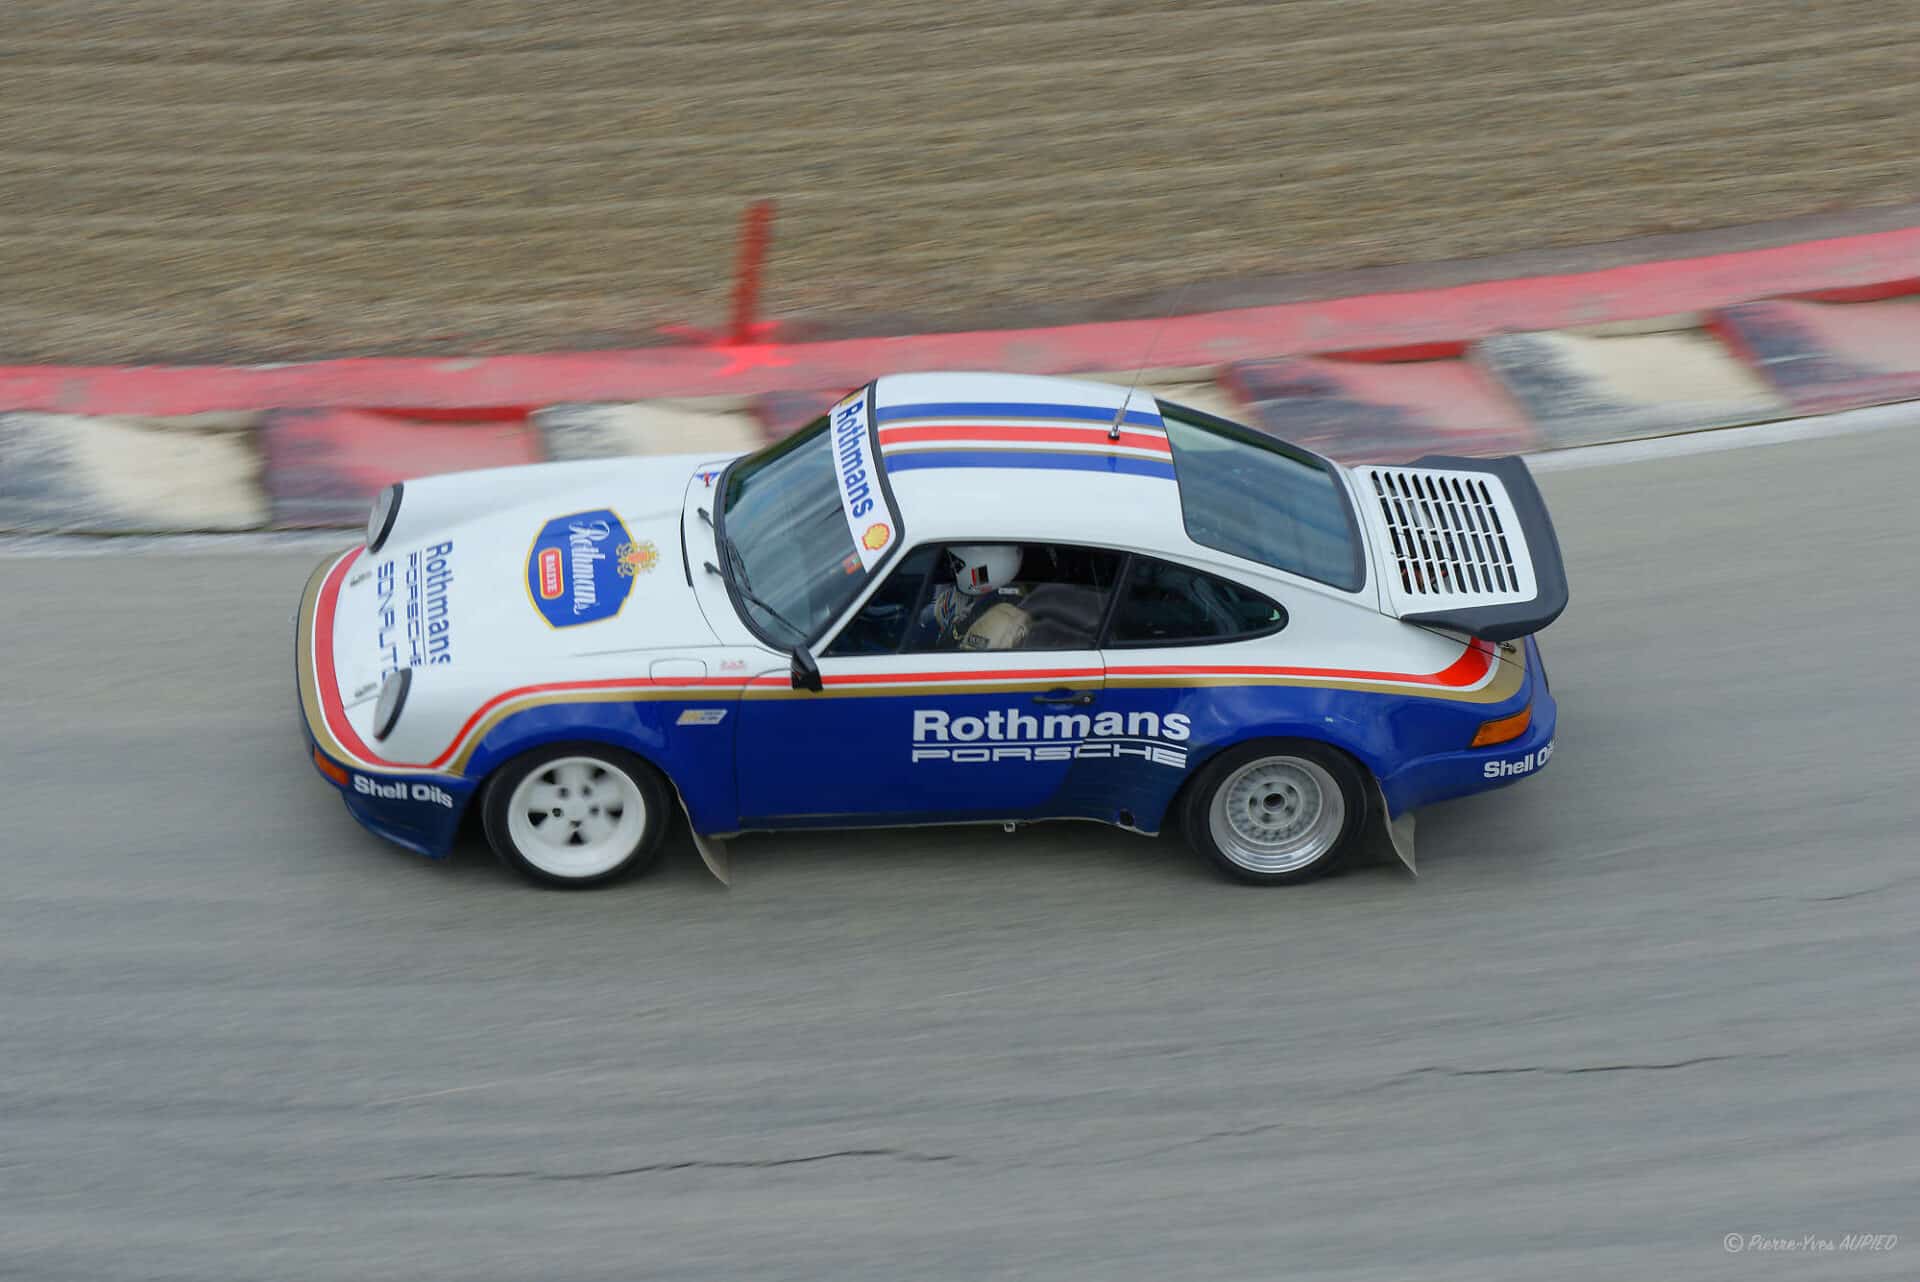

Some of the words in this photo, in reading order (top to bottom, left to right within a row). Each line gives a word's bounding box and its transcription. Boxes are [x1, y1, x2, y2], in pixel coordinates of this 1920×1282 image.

[837, 400, 874, 519] Rothmans
[568, 519, 610, 615] Rothmans
[426, 540, 454, 664] Rothmans
[912, 708, 1192, 741] Rothmans
[911, 743, 1188, 769] PORSCHE
[1483, 753, 1535, 778] Shell
[353, 774, 408, 800] Shell
[411, 783, 454, 808] Oils
